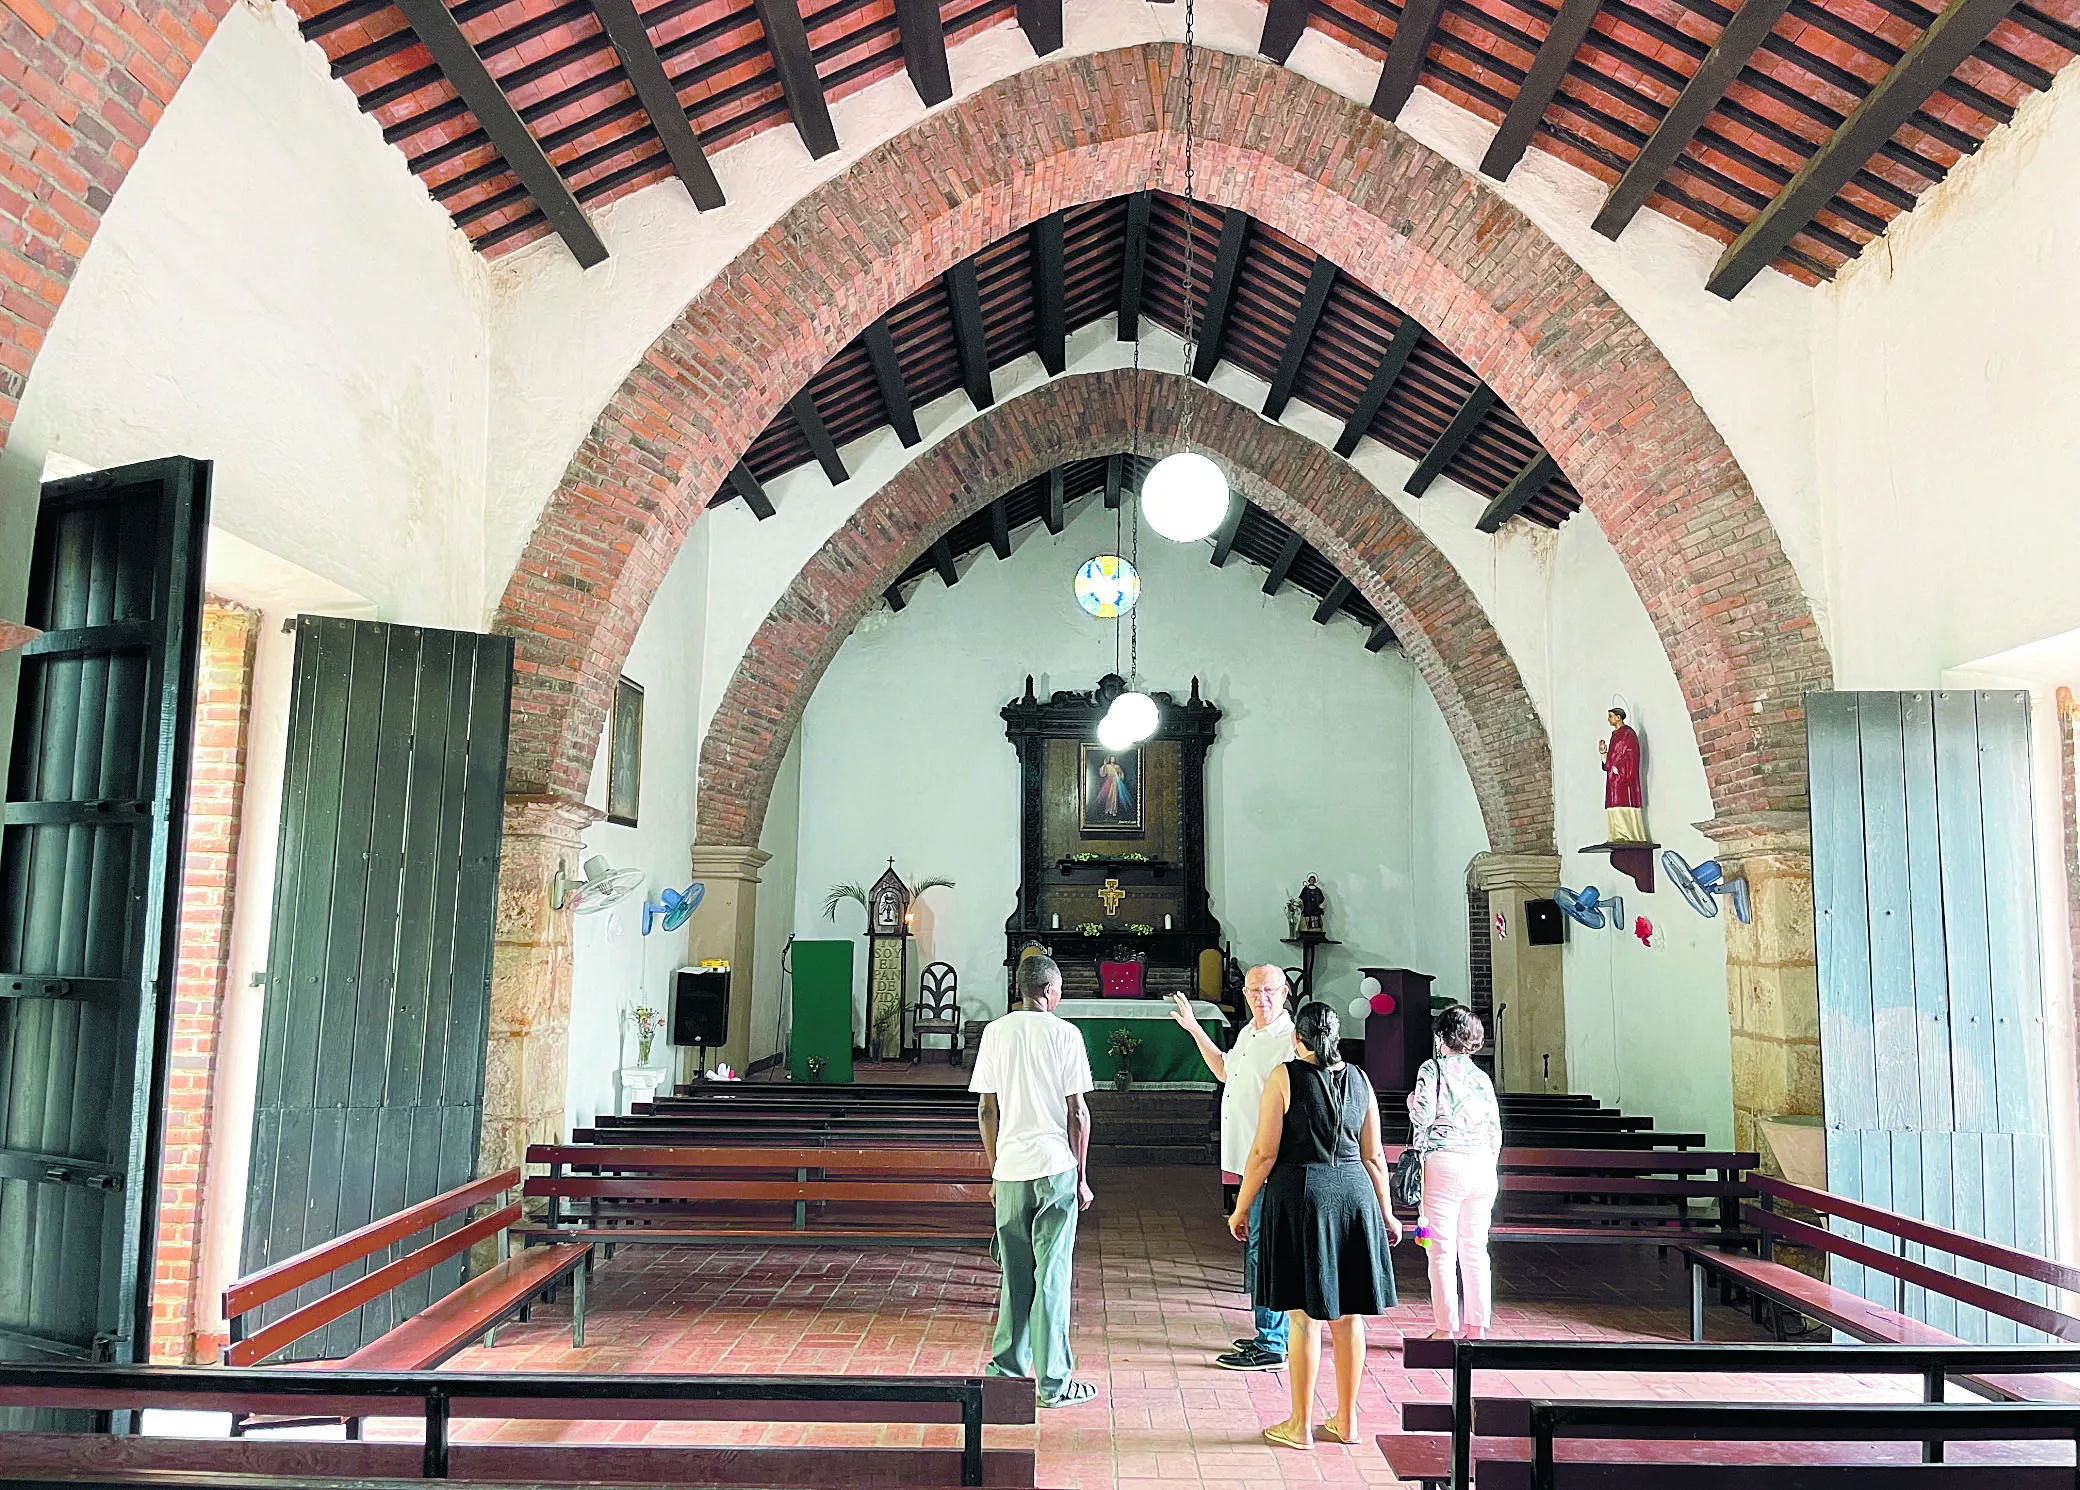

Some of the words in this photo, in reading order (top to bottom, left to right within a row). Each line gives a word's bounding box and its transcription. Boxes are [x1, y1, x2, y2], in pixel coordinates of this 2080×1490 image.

[874, 948, 902, 959] SOY
[879, 959, 897, 970] EL
[874, 969, 901, 981] PAN
[877, 981, 897, 992] DE
